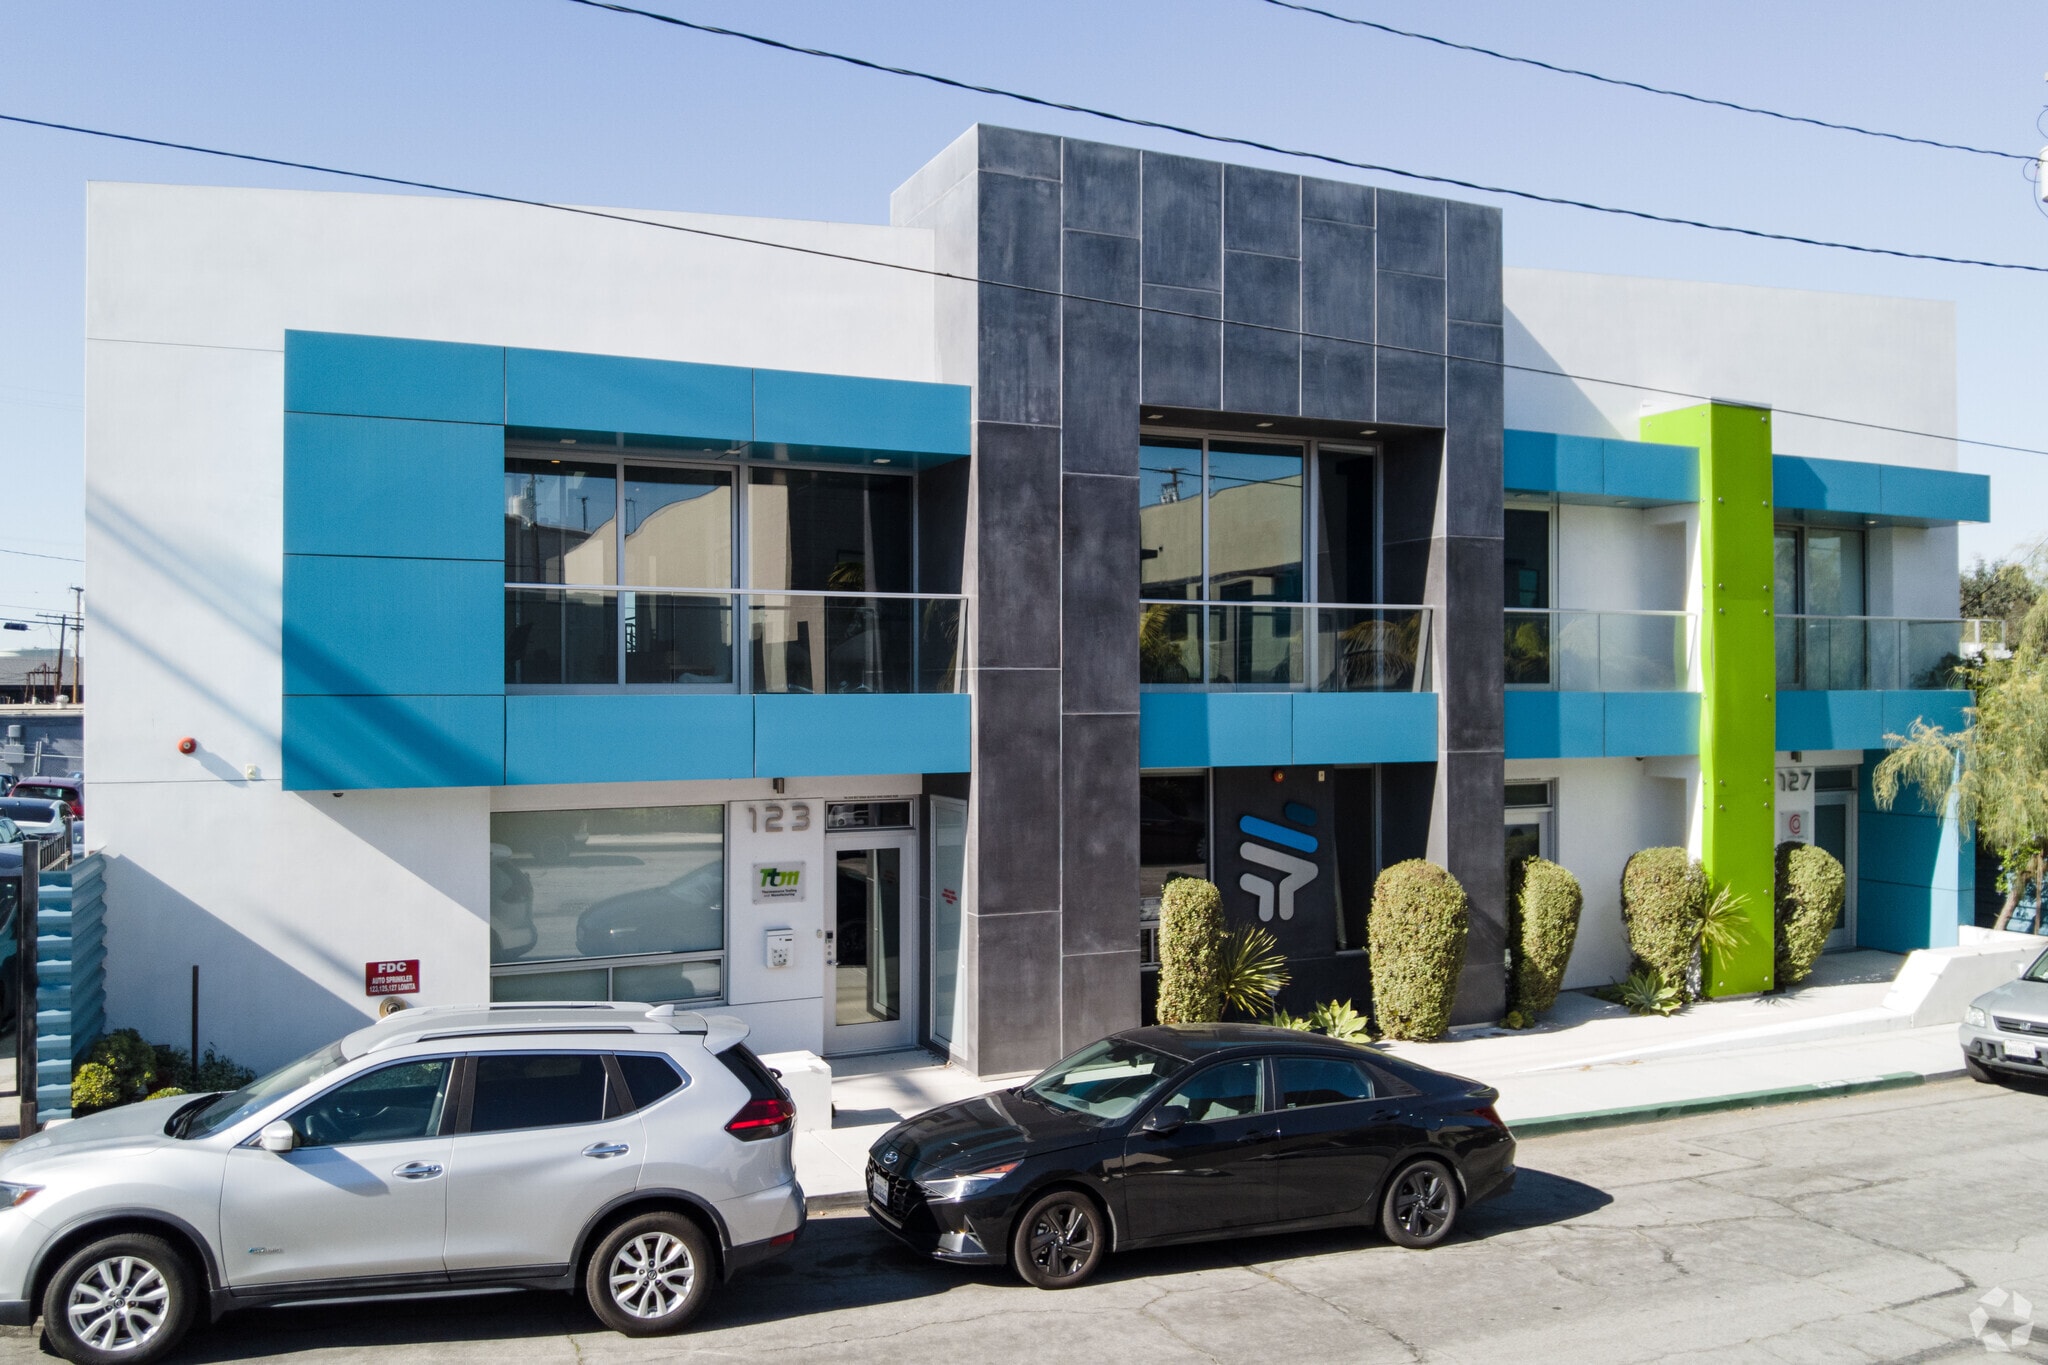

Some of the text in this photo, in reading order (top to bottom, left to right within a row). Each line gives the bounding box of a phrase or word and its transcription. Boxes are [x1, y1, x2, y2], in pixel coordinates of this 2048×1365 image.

[1779, 771, 1812, 791] 127
[749, 804, 810, 833] 123
[378, 962, 407, 973] FDC
[386, 975, 413, 983] SPRINKLER
[398, 983, 415, 991] LOMITA
